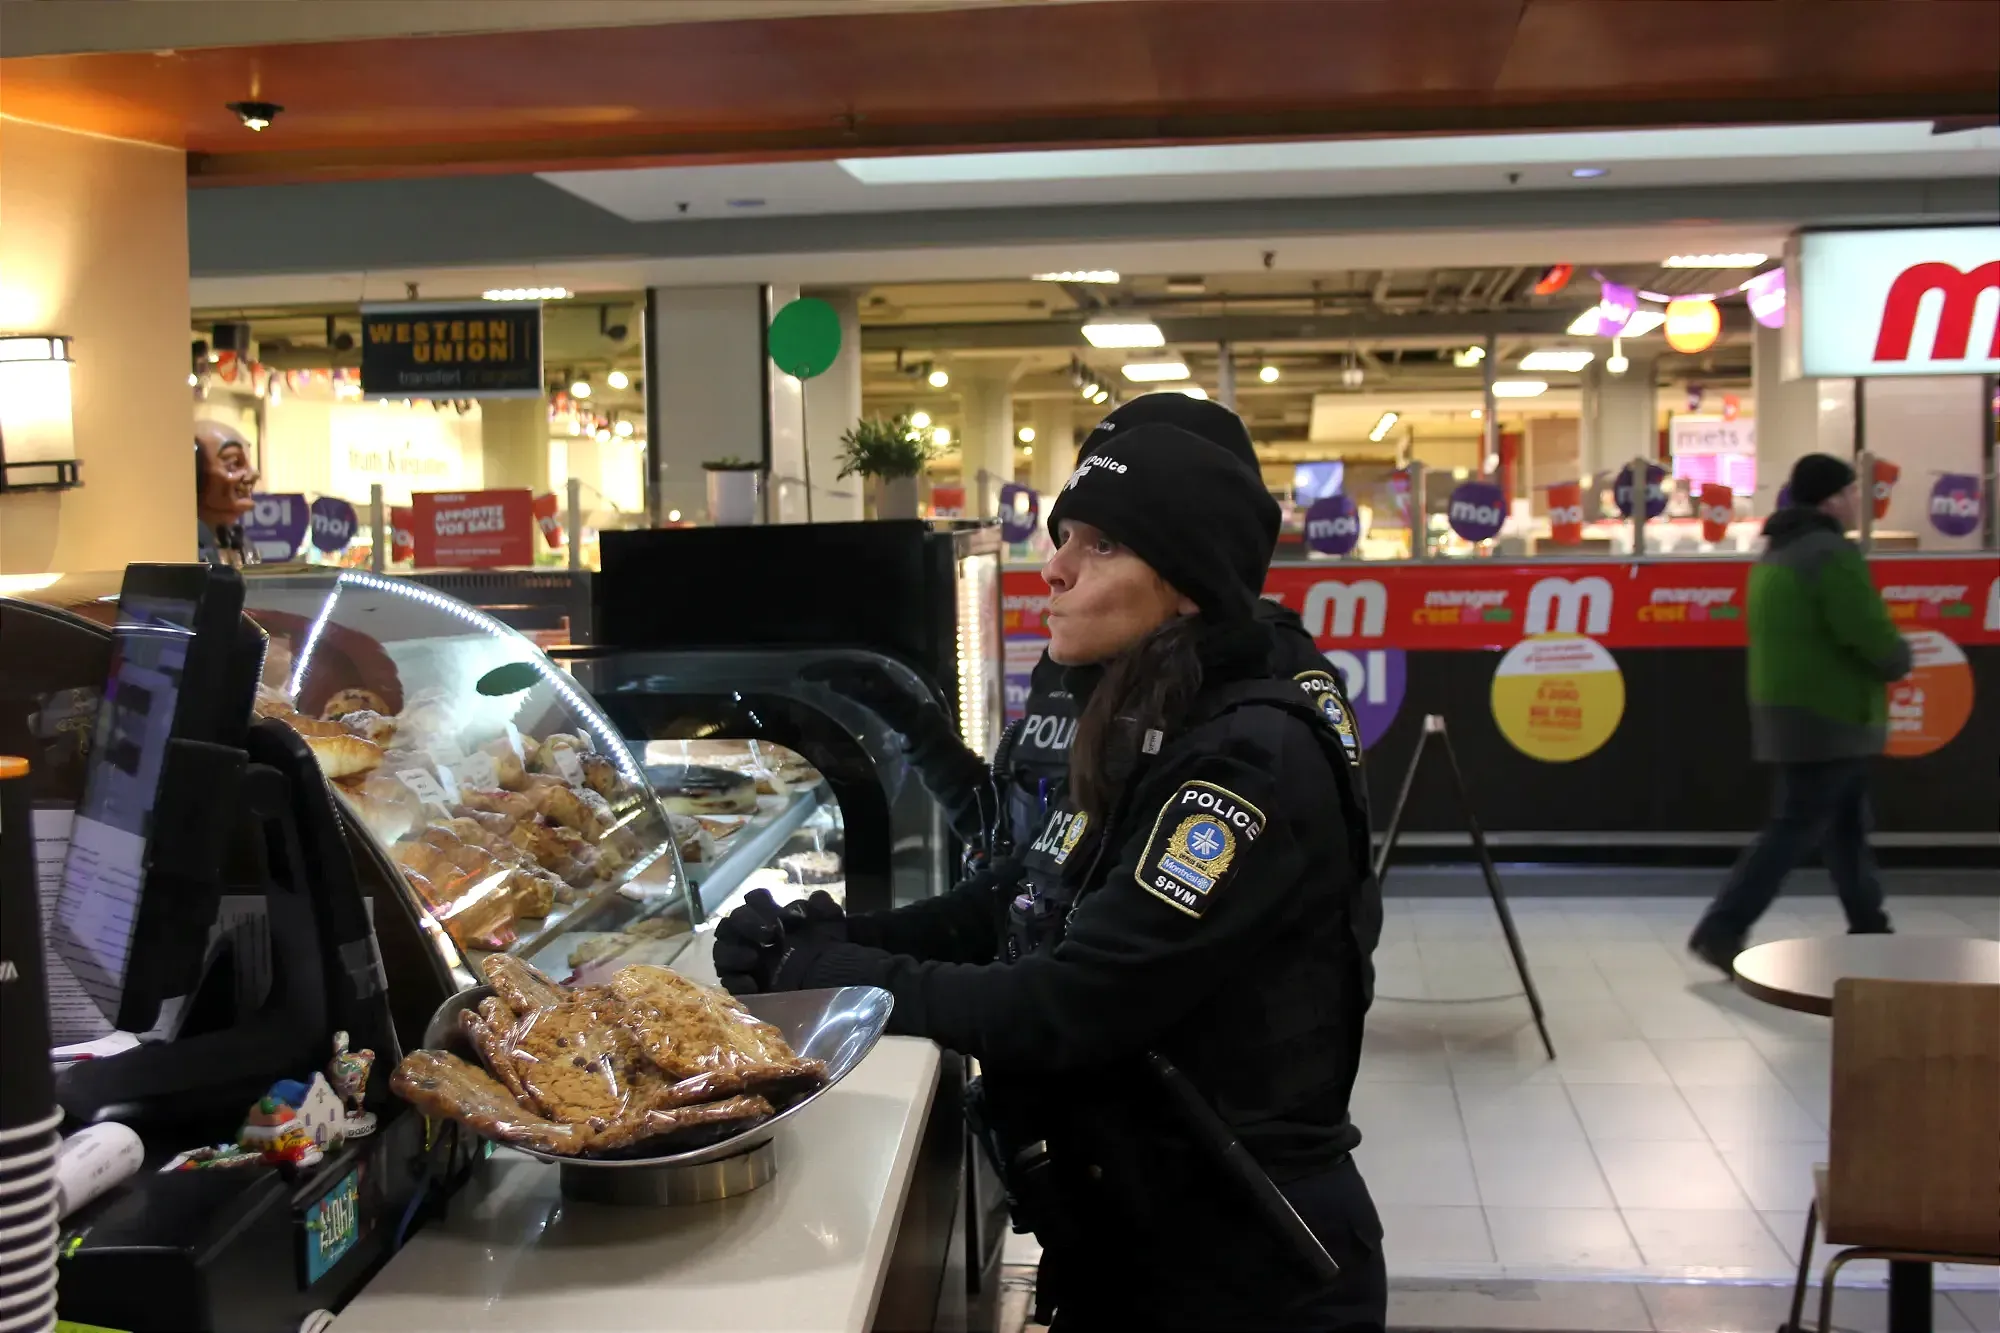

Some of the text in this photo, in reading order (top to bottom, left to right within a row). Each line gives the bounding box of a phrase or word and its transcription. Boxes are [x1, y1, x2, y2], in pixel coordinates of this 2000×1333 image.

[368, 320, 507, 343] WESTERN
[413, 342, 508, 363] UNION
[1088, 455, 1128, 475] Police
[1308, 513, 1357, 539] moi
[1452, 500, 1500, 526] moi
[436, 521, 466, 537] VOS
[1018, 713, 1079, 750] POLI
[1181, 790, 1261, 841] POLICE
[1163, 858, 1200, 885] Montréal
[1155, 876, 1197, 906] SPVM
